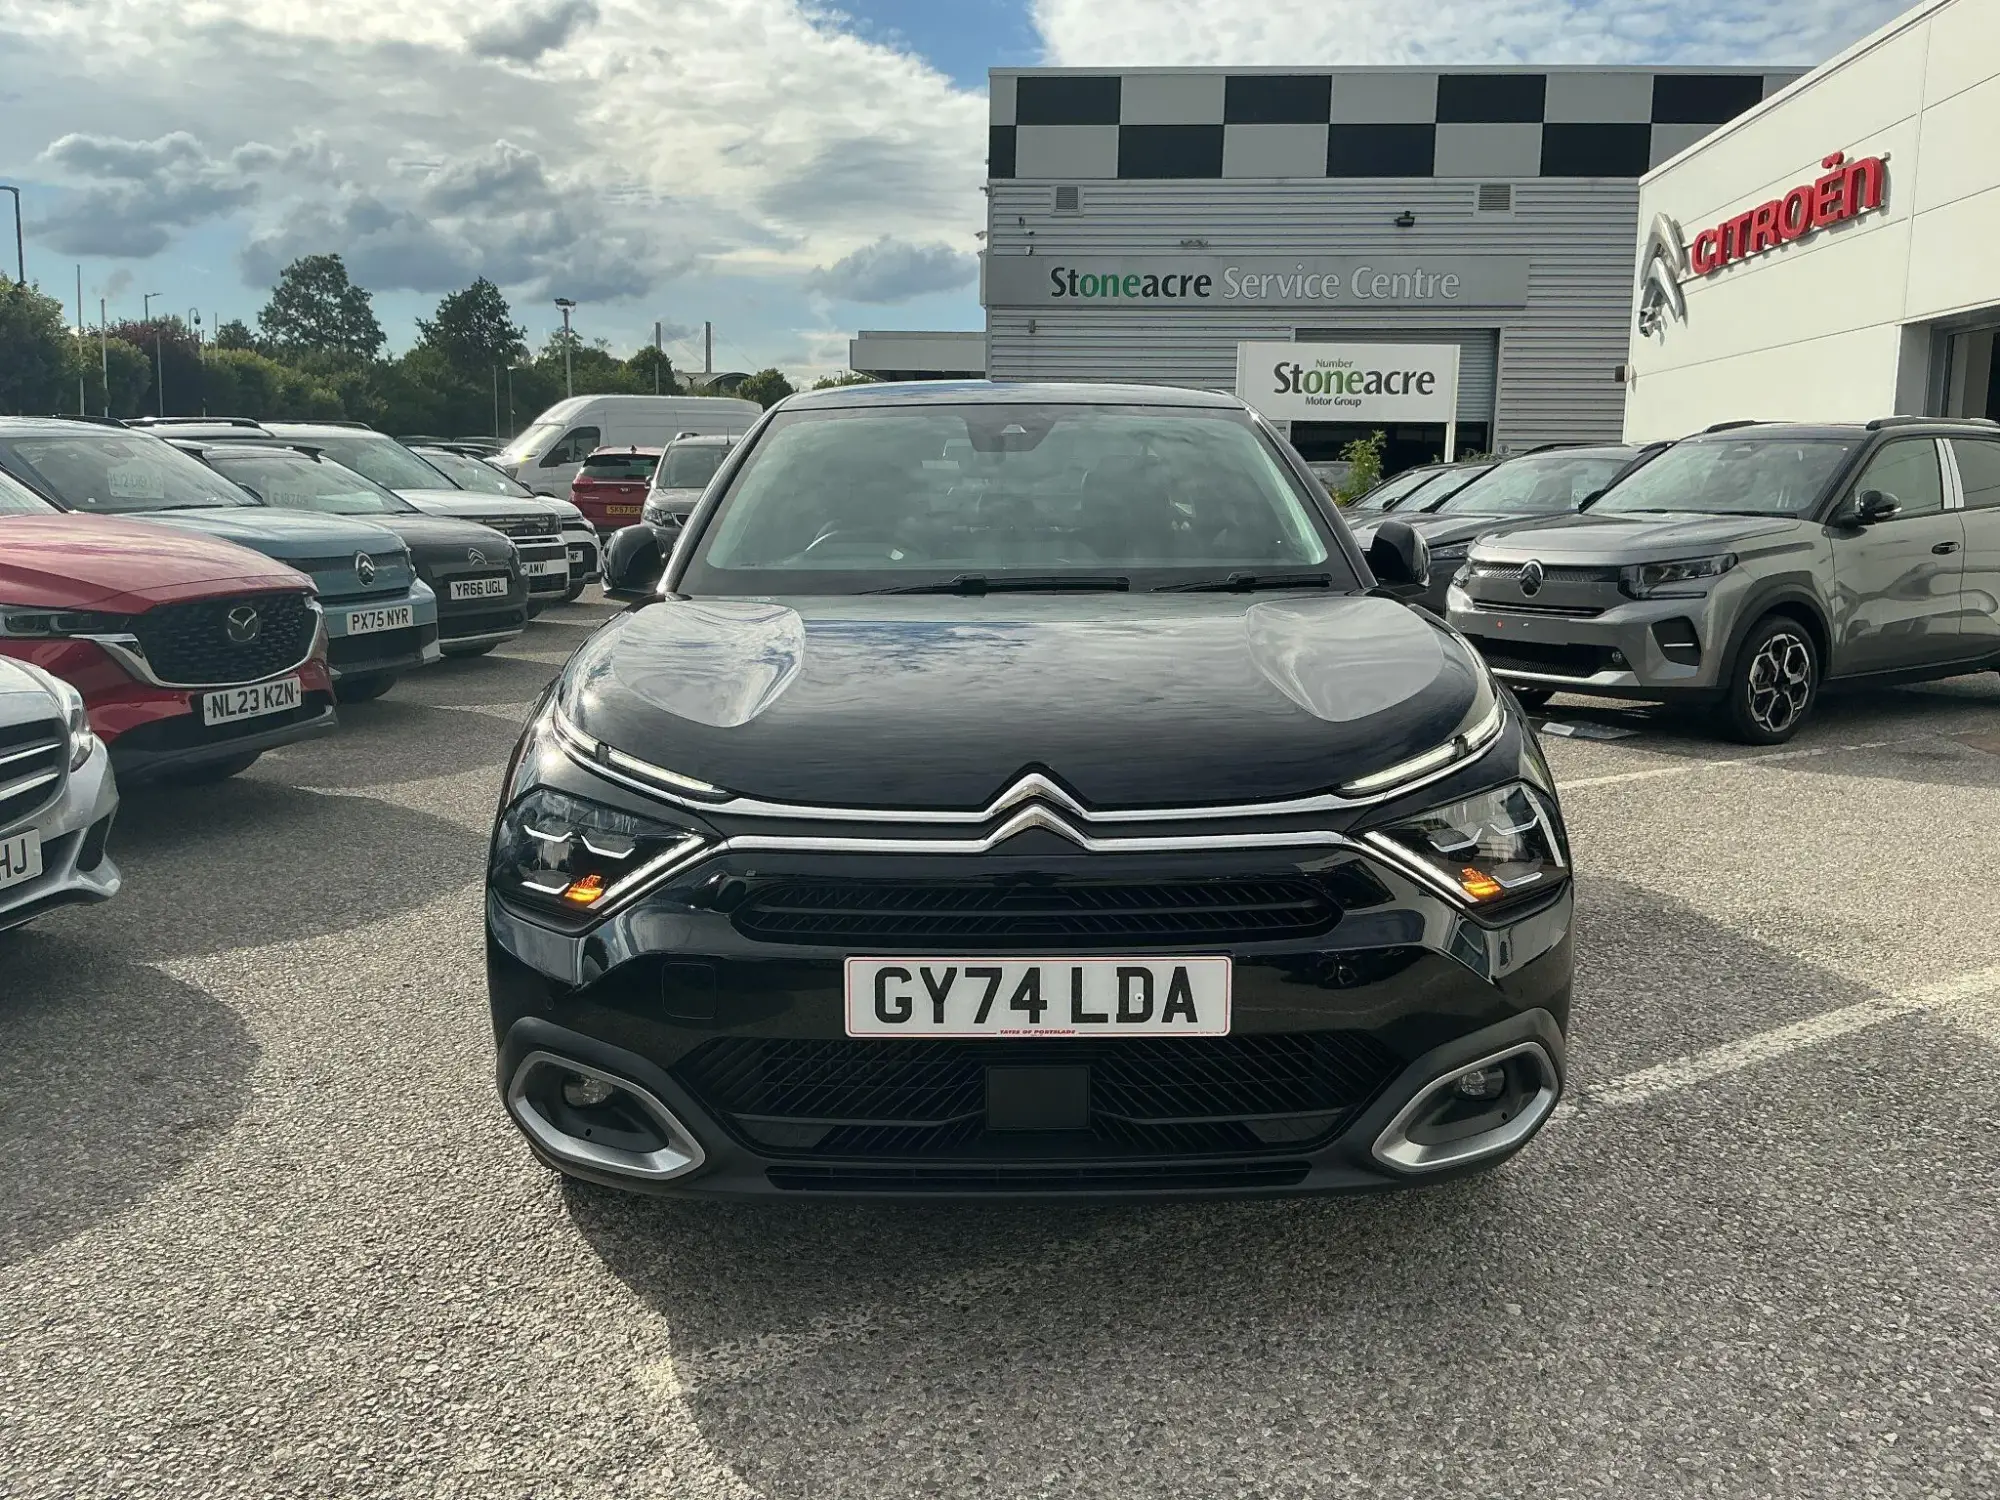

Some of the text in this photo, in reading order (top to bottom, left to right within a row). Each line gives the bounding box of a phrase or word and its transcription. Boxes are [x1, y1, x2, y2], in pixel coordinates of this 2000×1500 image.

[1050, 263, 1460, 299] Stoneacre Service Centre
[1315, 358, 1354, 368] Number
[1273, 361, 1436, 395] Stoneacre
[1305, 396, 1362, 408] Motor Group
[528, 563, 545, 574] AMV
[455, 580, 504, 597] YR66 UGL
[352, 608, 409, 631] PX75 NYR
[212, 682, 294, 718] NL23 KZN
[874, 966, 1198, 1024] GY74 LDA
